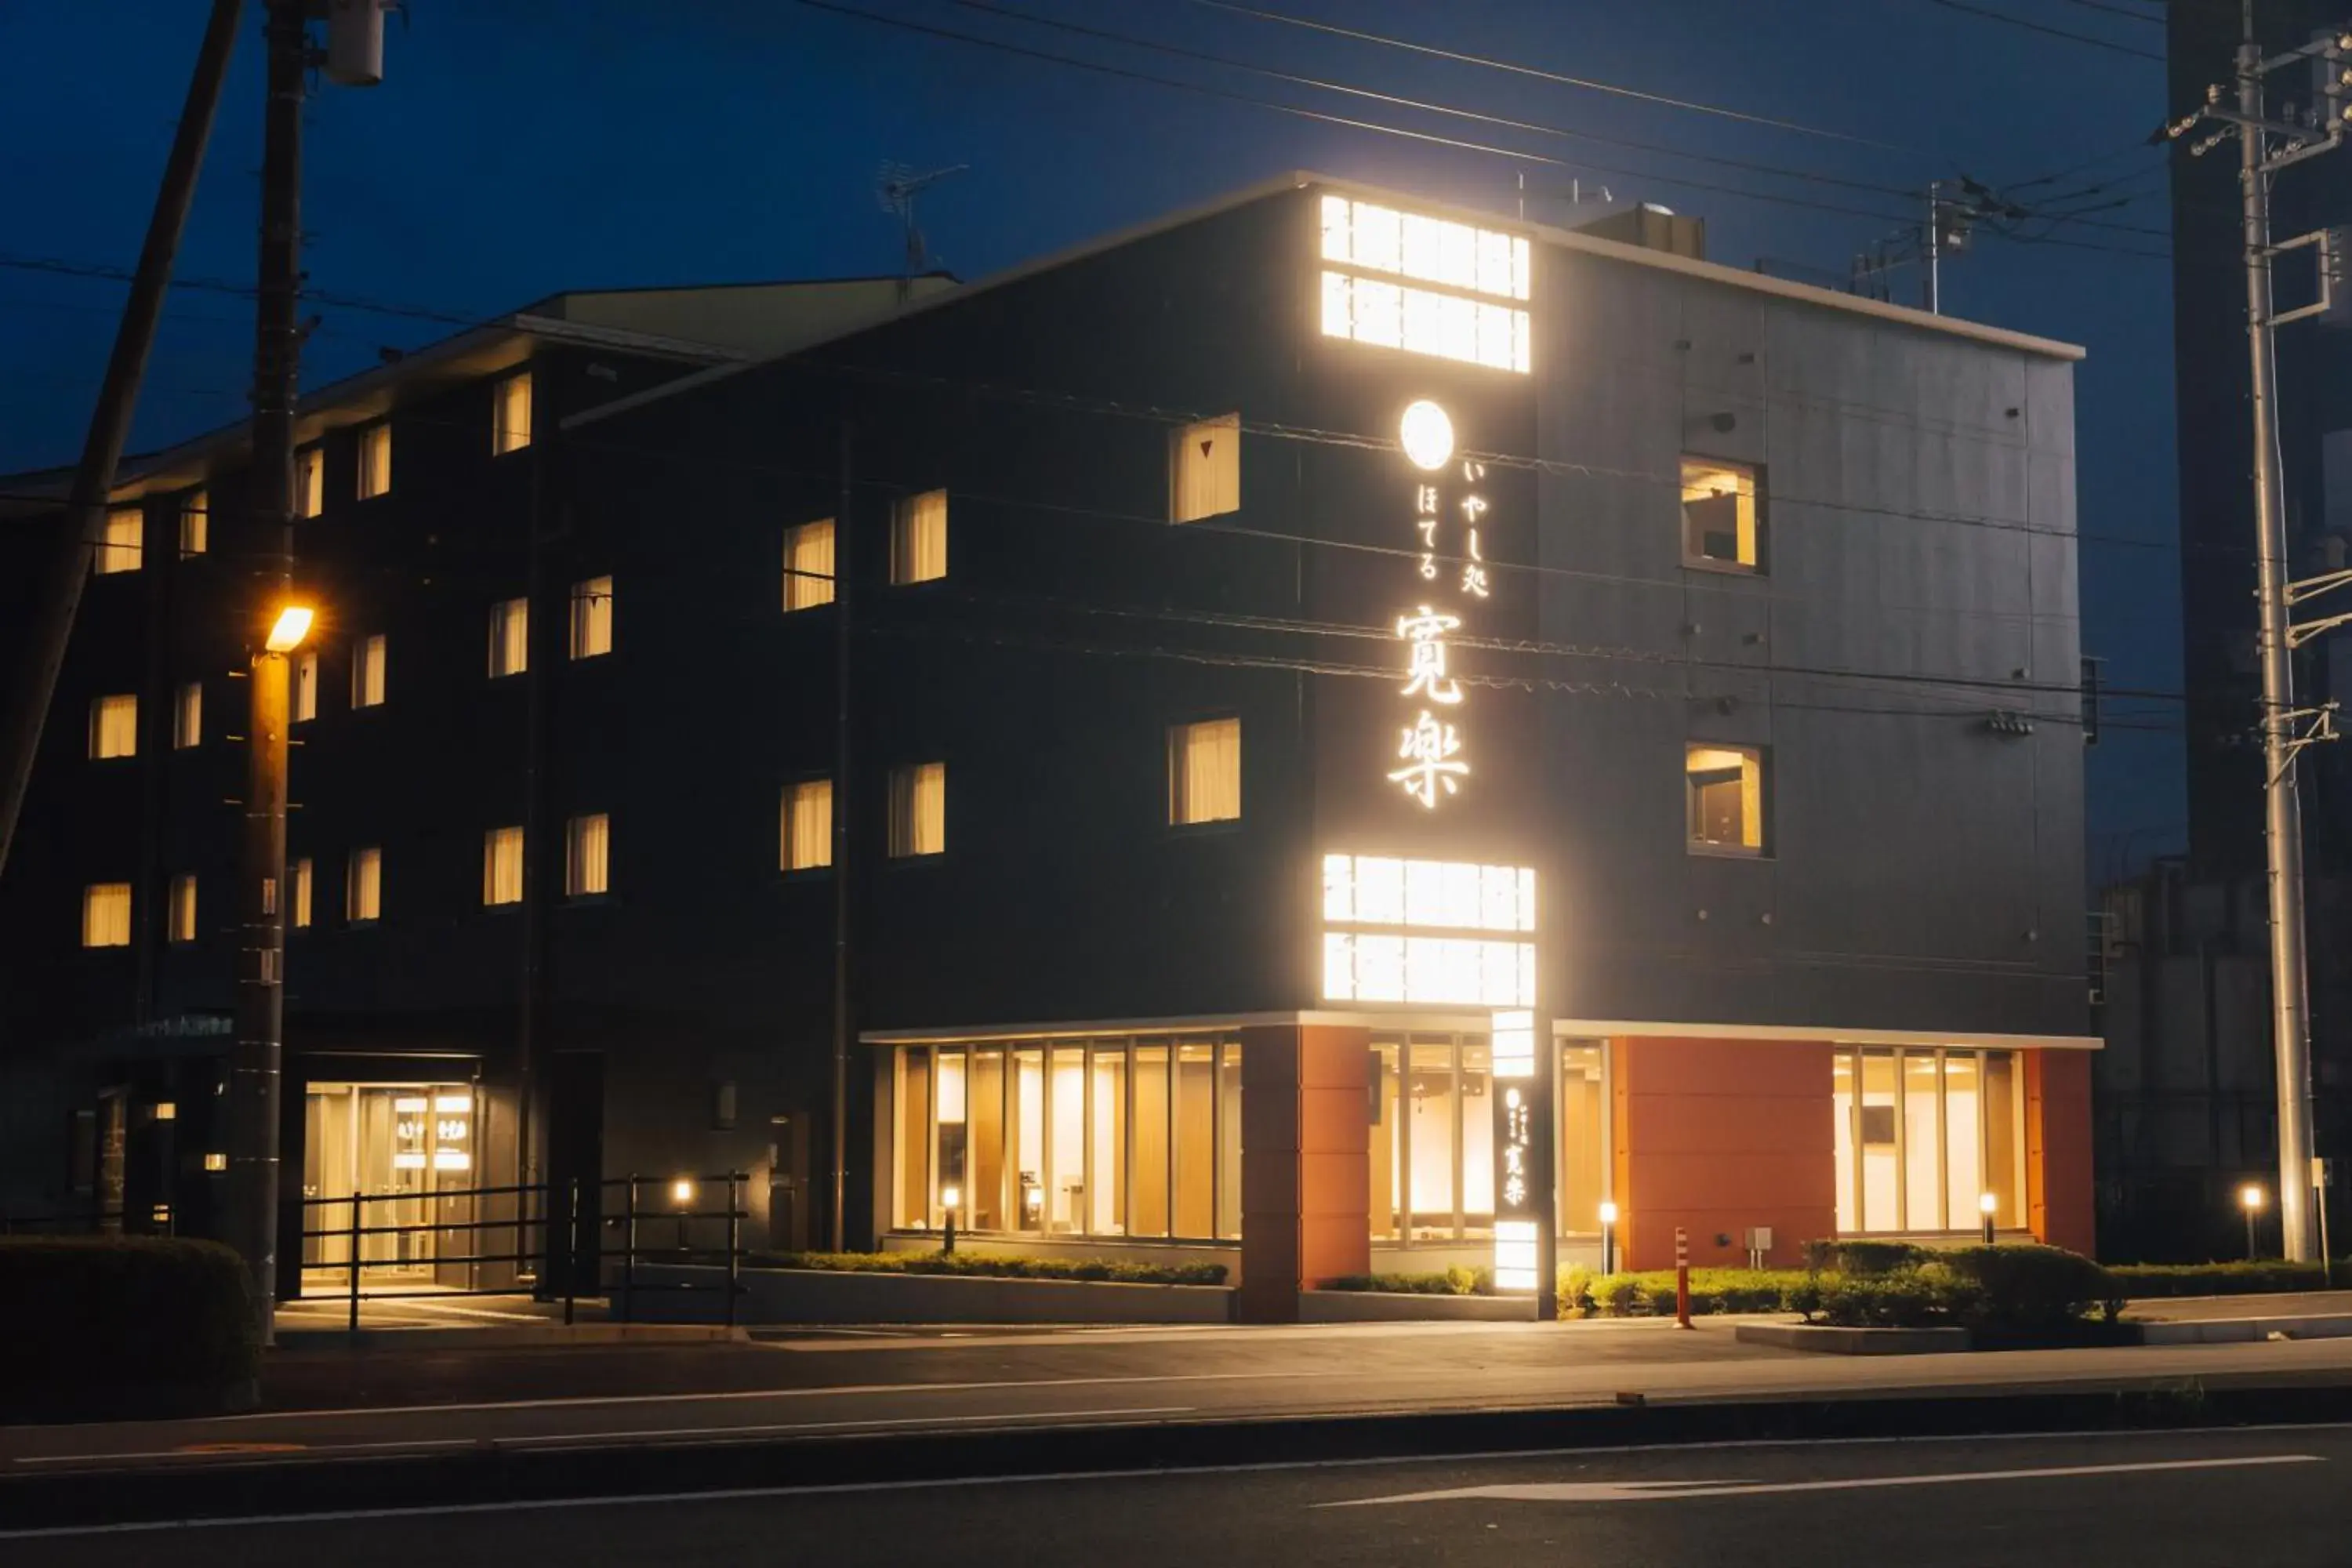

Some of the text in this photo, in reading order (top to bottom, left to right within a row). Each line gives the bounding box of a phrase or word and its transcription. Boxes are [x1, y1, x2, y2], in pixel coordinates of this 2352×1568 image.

[1417, 485, 1438, 580] ほてる
[1461, 462, 1490, 597] いやし処
